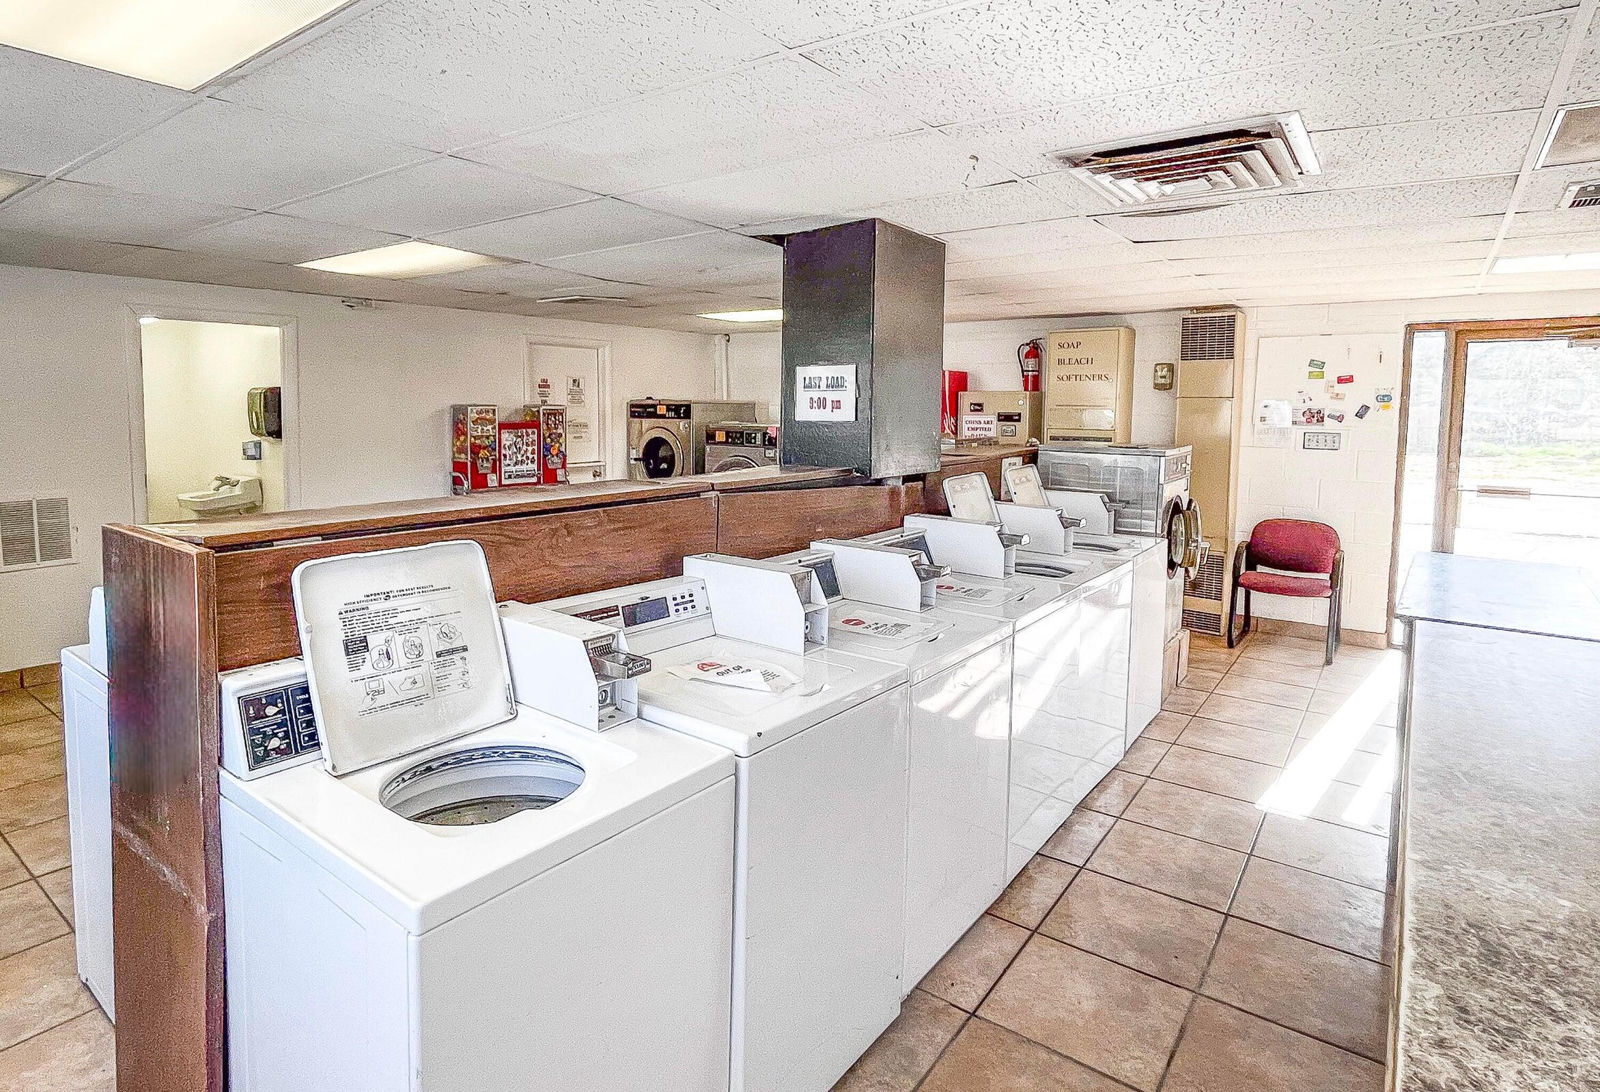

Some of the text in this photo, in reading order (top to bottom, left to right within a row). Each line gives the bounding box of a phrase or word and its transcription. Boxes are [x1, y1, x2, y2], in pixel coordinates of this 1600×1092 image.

[1057, 341, 1081, 350] SOAP
[1057, 357, 1094, 366] BLEACH
[1056, 373, 1109, 382] SOFTENERS
[803, 376, 847, 389] LAST LOAD:
[809, 397, 841, 412] 9:00 pm
[344, 606, 369, 614] WARNING
[716, 668, 732, 676] OUT
